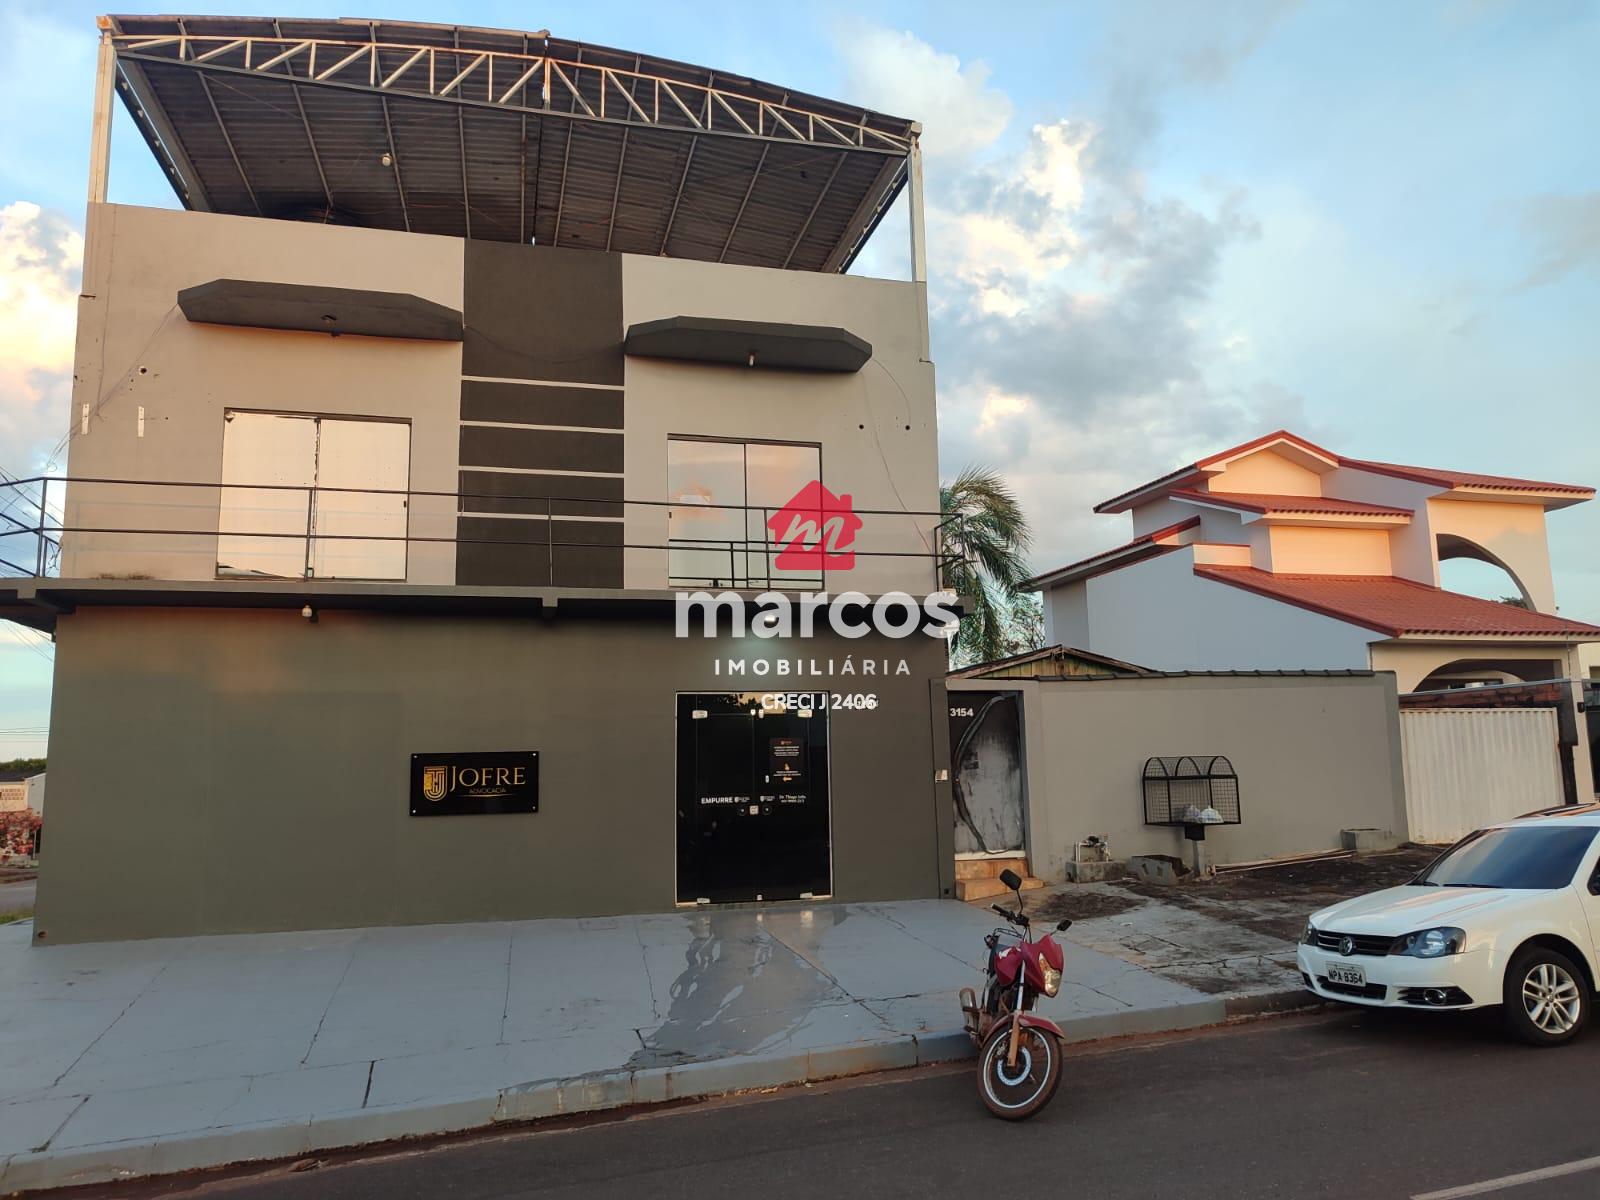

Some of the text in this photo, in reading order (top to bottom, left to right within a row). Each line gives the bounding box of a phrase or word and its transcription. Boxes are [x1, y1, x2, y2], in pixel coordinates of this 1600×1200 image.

[949, 707, 974, 717] 3154
[450, 766, 525, 791] JOFRE
[701, 796, 734, 804] EMPURRE
